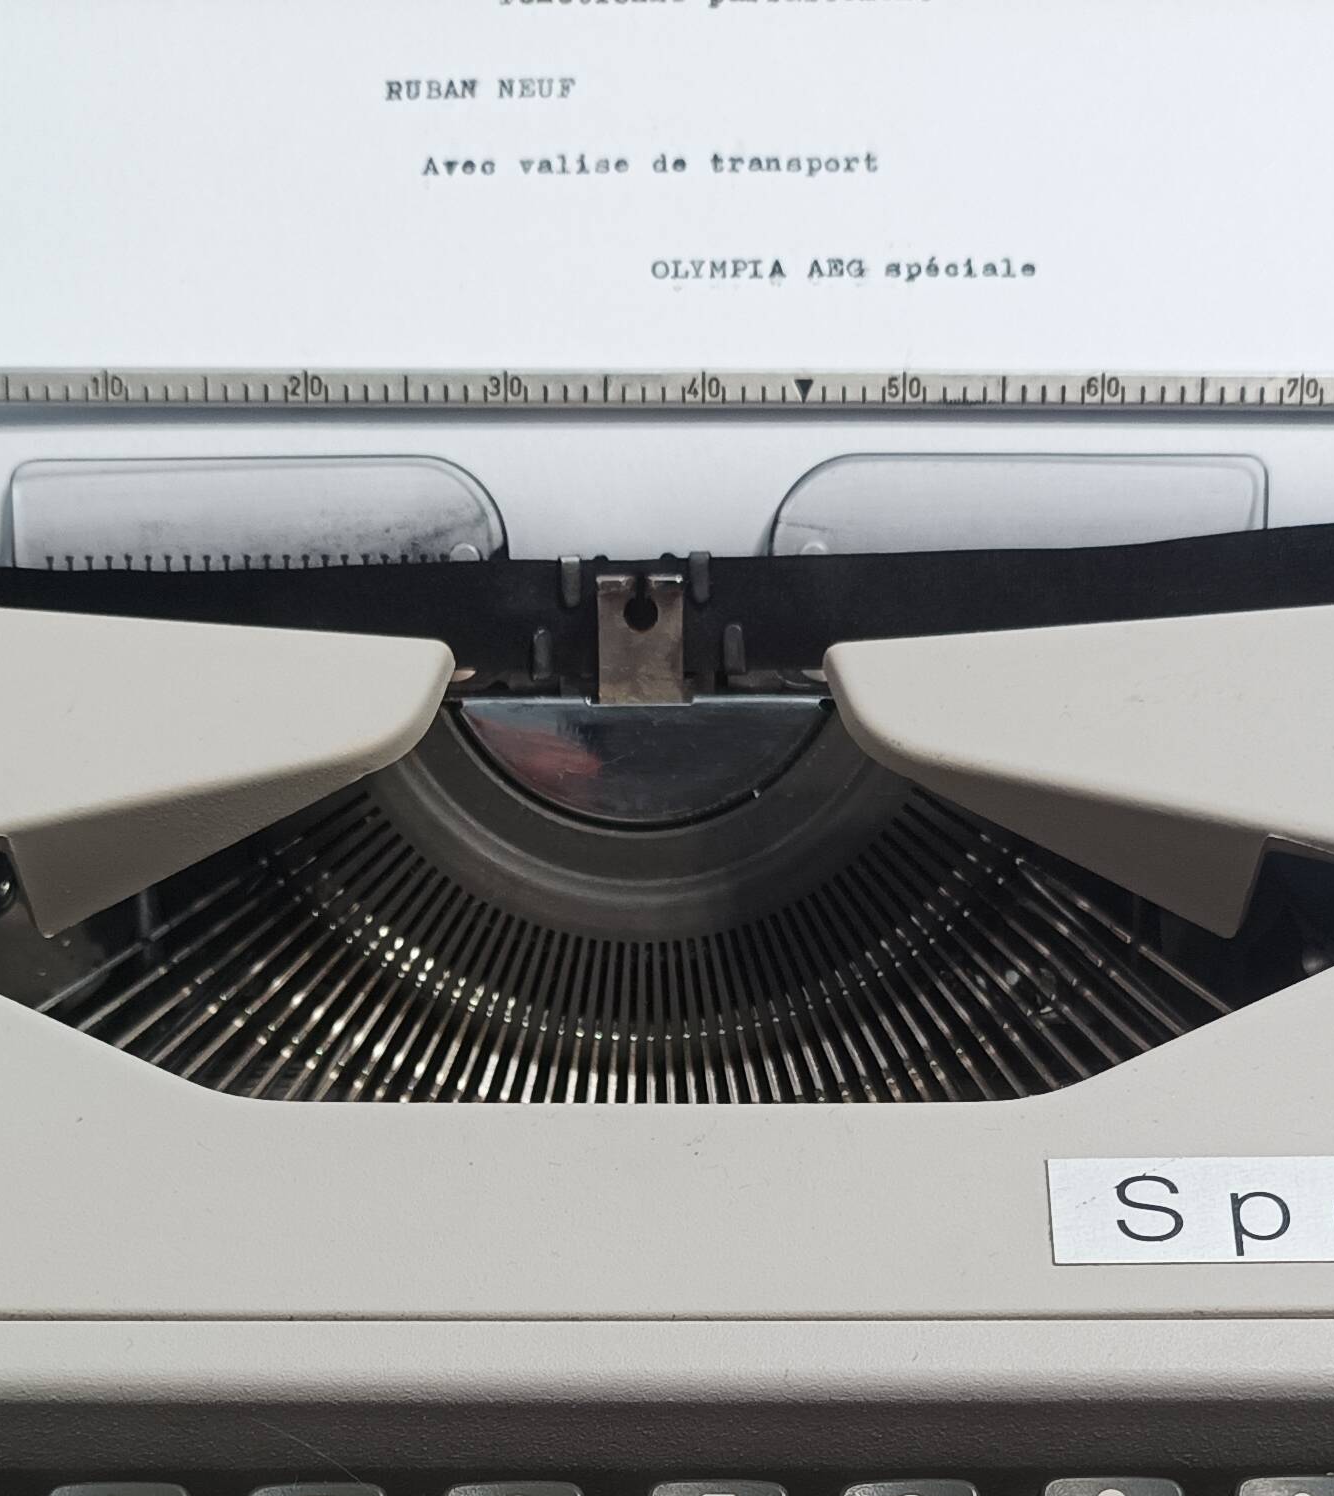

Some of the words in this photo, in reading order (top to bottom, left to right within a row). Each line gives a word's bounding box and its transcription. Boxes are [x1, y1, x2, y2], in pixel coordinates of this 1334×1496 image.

[385, 78, 478, 101] RUBAN
[497, 77, 576, 99] NEUF
[422, 156, 496, 176] Avec
[519, 153, 629, 175] valise
[652, 153, 687, 173] de
[710, 151, 878, 177] transport
[651, 258, 787, 279] OLYMPIA
[807, 258, 866, 279] AEG
[884, 255, 1036, 283] spéciale
[90, 375, 124, 398] 10
[288, 374, 324, 397] 20
[488, 375, 523, 398] 30
[686, 376, 721, 399] 40
[886, 376, 922, 399] 50
[1085, 376, 1120, 399] 60
[1286, 377, 1319, 399] 70
